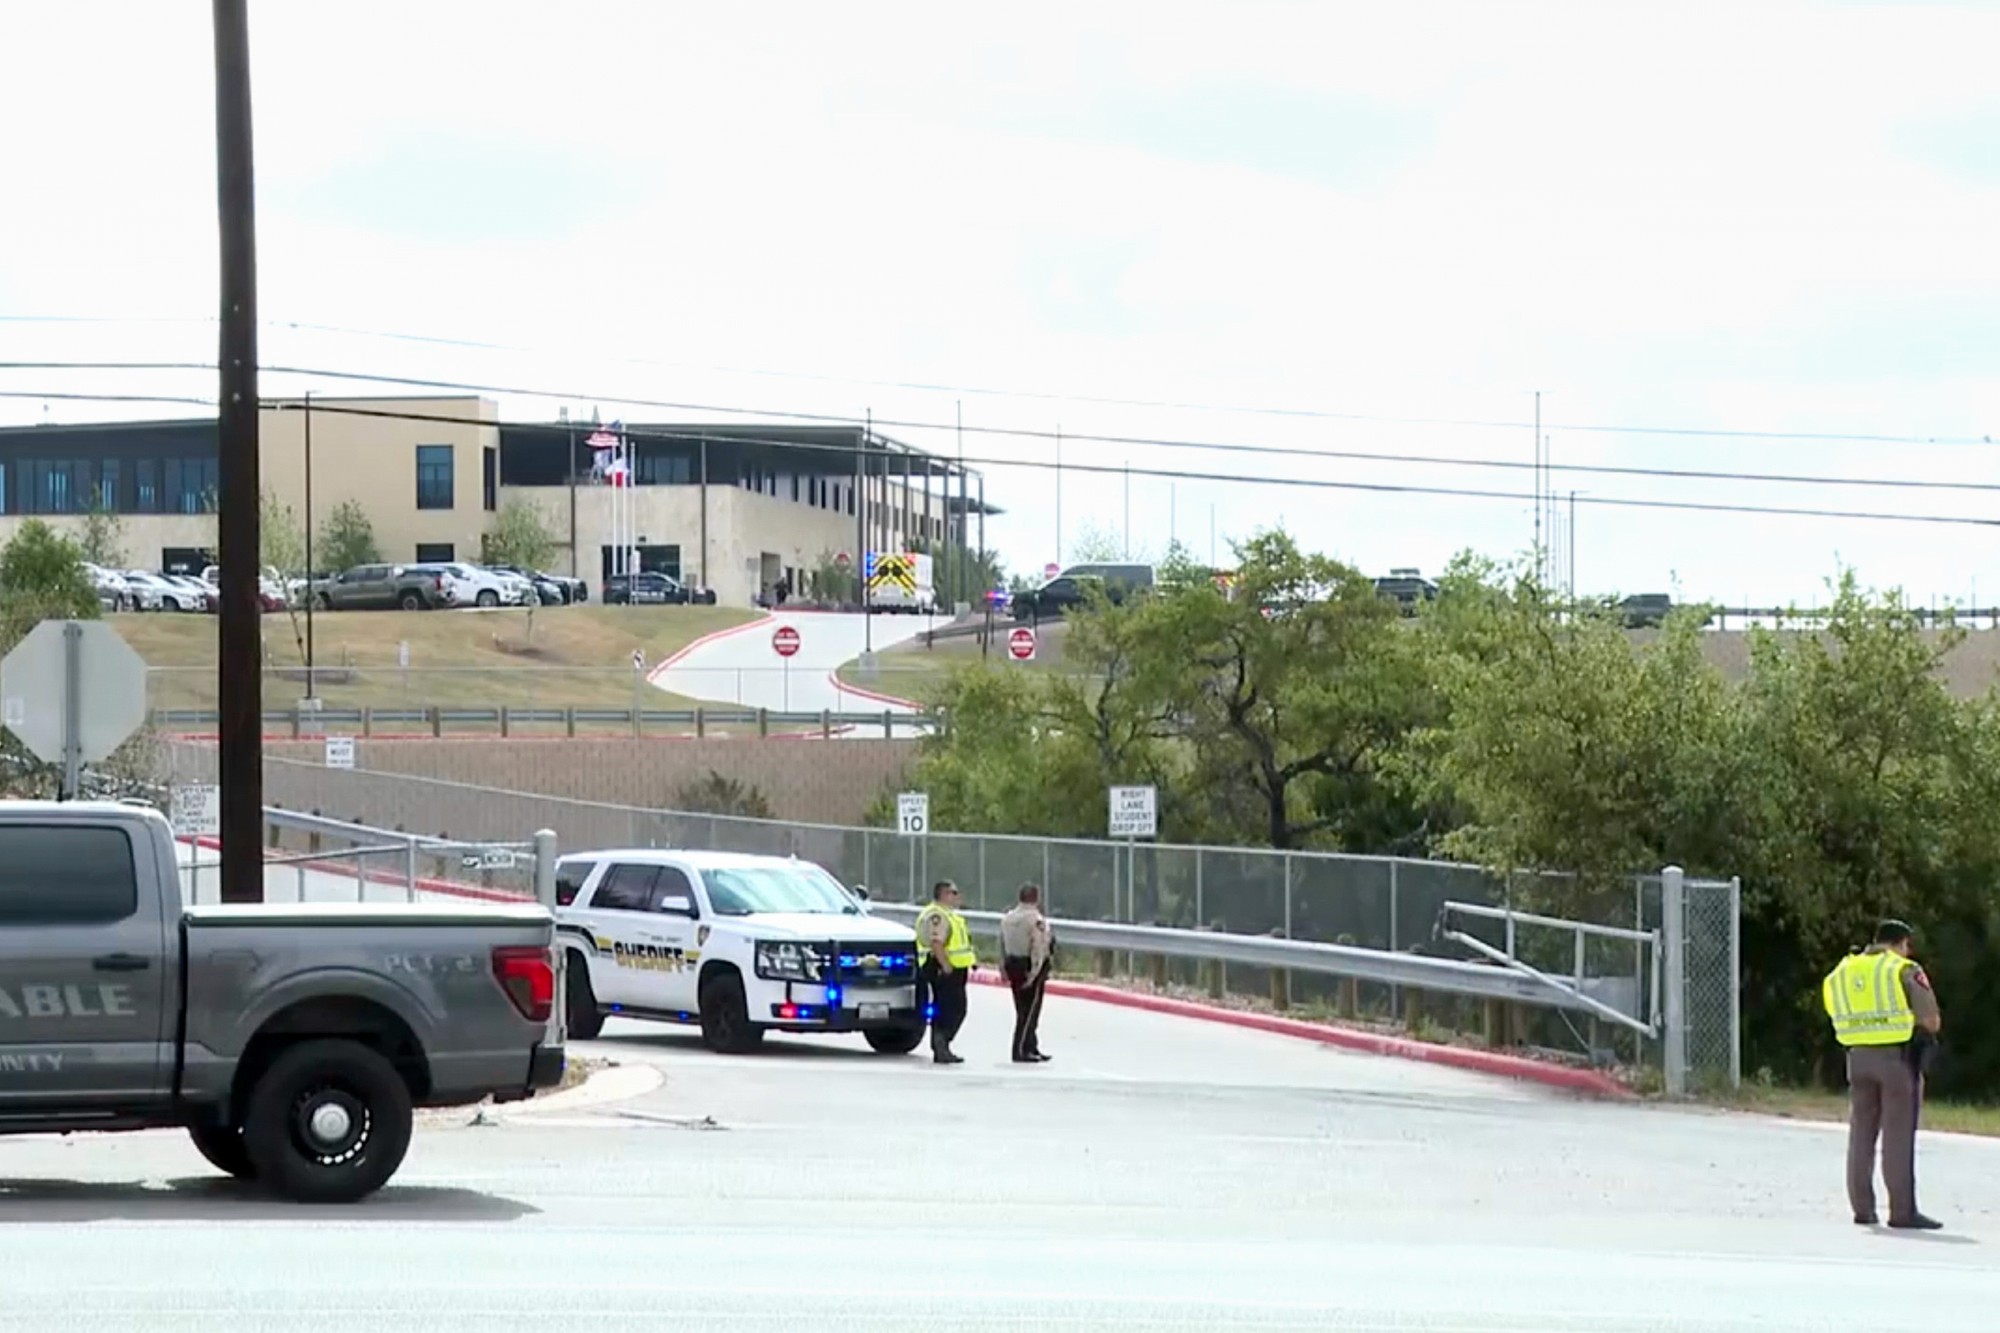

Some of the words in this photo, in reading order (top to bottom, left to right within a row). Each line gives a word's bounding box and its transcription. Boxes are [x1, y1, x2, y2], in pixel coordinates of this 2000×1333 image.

[900, 797, 926, 805] SPEED
[1120, 800, 1144, 810] LANE
[902, 806, 923, 814] LIMIT
[1114, 811, 1152, 821] STUDENT
[903, 815, 924, 832] 10
[613, 940, 685, 974] SHERIFF
